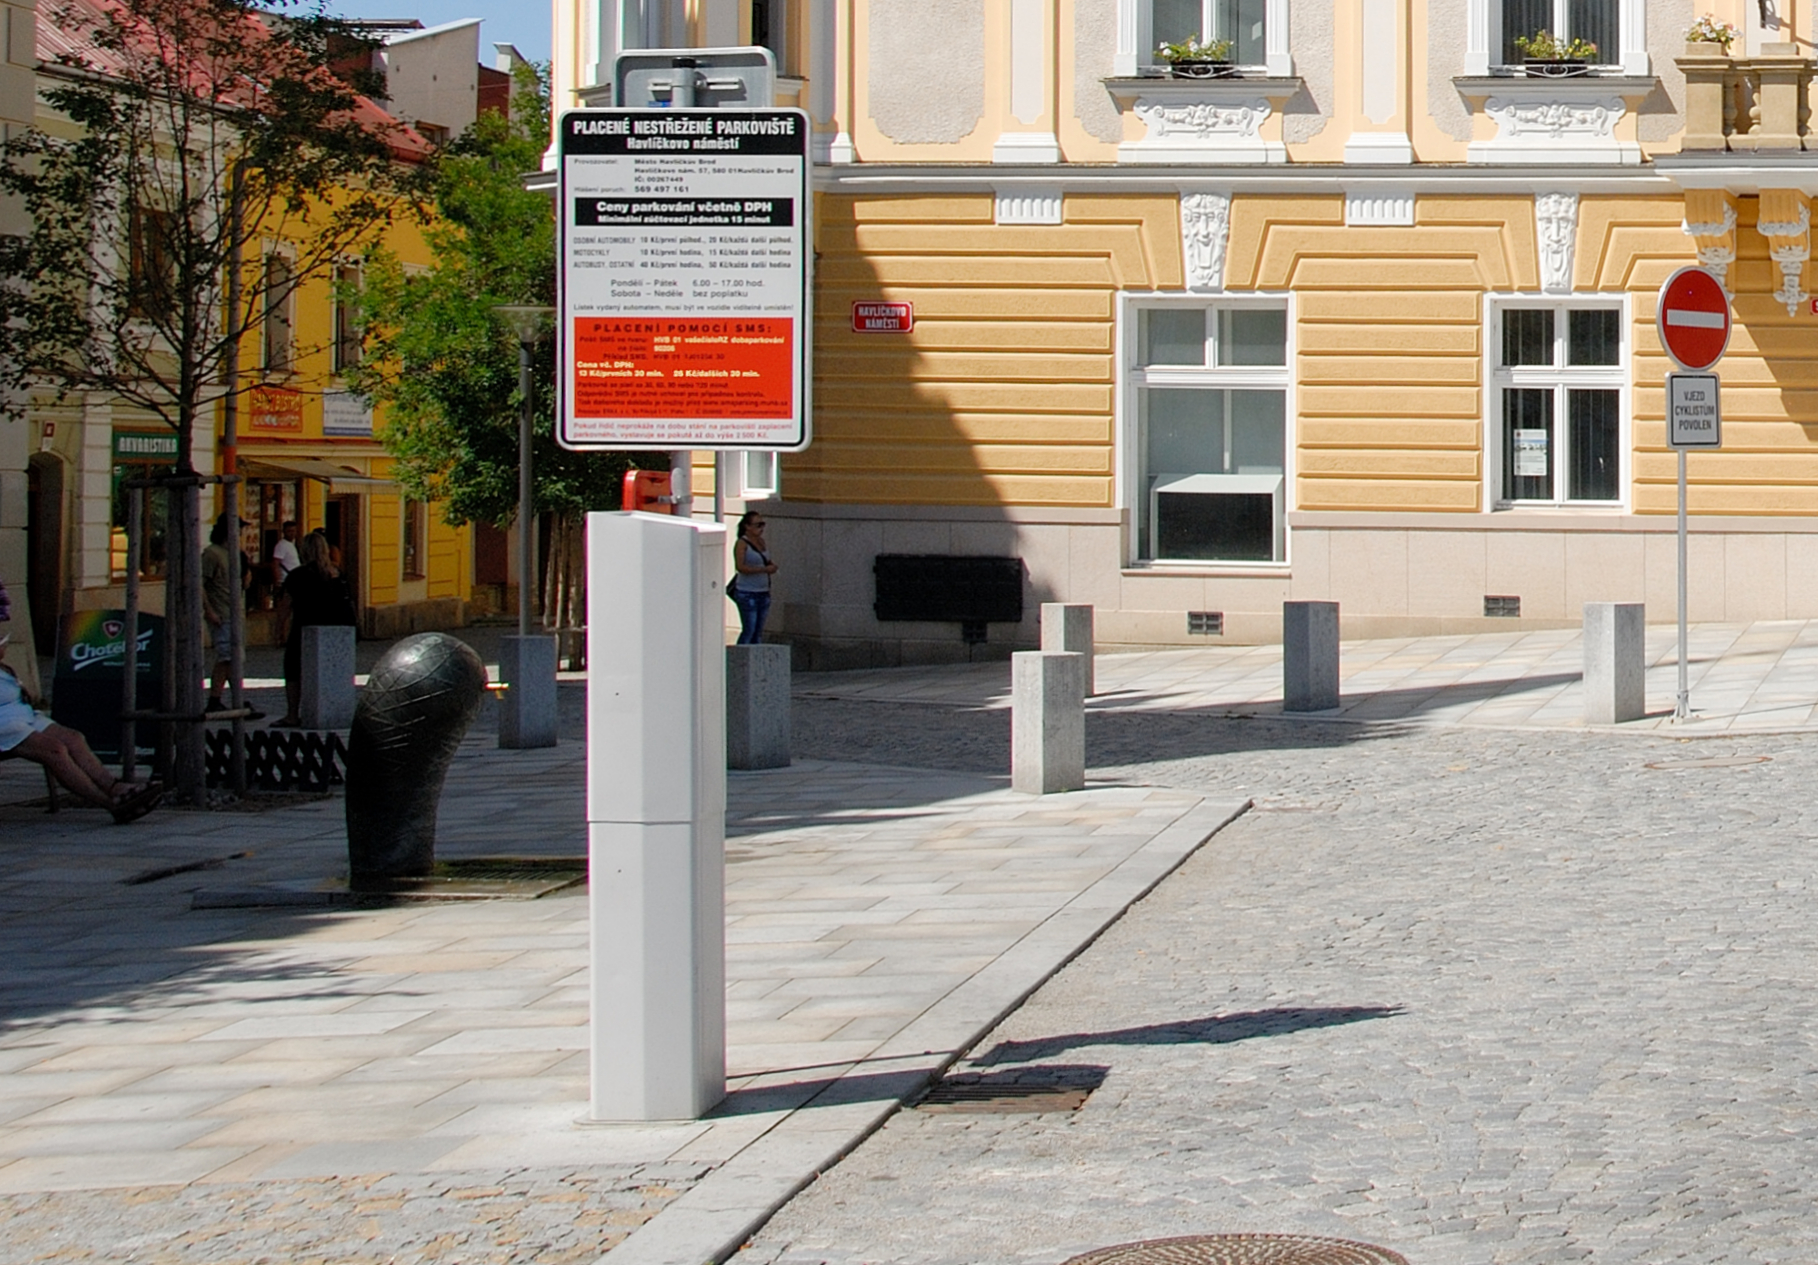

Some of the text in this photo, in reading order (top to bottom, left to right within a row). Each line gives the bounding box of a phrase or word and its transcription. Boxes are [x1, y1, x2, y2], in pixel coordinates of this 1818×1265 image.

[573, 117, 794, 135] PLACENÉ NESTŘEŽENÉ PARKOVIŠTĚ
[627, 137, 739, 150] Havlíčkovo náměstí
[634, 185, 652, 193] 569
[653, 185, 671, 193] 497
[673, 185, 689, 193] 161
[596, 201, 772, 214] Ceny parkování včetně DPH
[573, 236, 596, 245] OSOBNÍ
[597, 236, 636, 244] AUTOMOBILY
[610, 279, 644, 287] Pondělí
[653, 279, 678, 287] Pátek
[692, 279, 711, 287] 6.00
[721, 279, 745, 287] 17.00
[610, 289, 748, 299] Sobota Neděle bez poplatku
[858, 305, 907, 317] HAVLÍČKOVO
[592, 323, 771, 333] PLACENÍ POMOCÍ SMS:
[865, 317, 900, 329] NÁMĚSTÍ
[1683, 390, 1706, 402] VJEZD
[1674, 402, 1715, 416] CYKLISTŮM
[1678, 420, 1712, 431] POVOLEN
[118, 436, 178, 453] AKVARISTIKA
